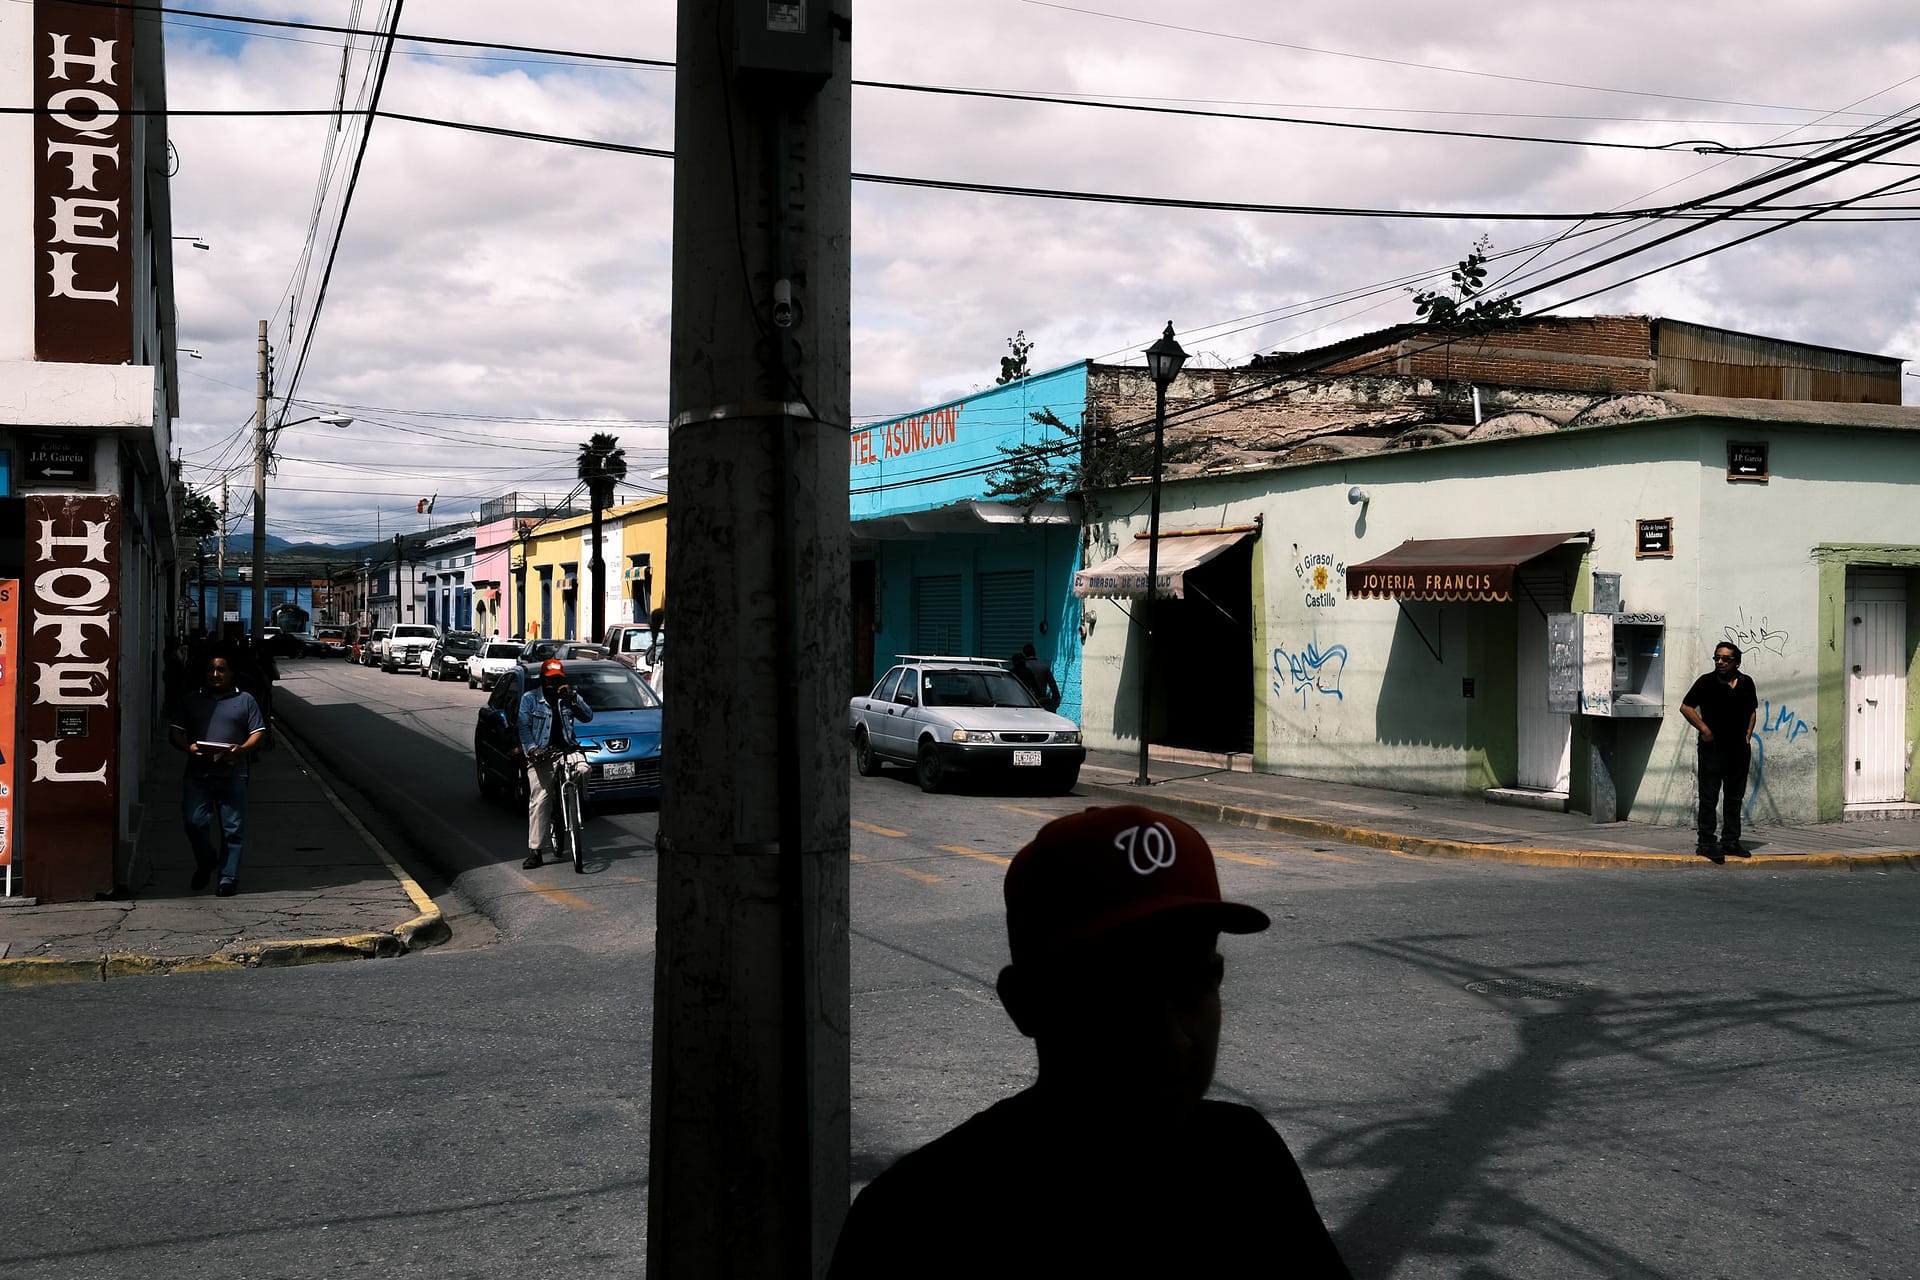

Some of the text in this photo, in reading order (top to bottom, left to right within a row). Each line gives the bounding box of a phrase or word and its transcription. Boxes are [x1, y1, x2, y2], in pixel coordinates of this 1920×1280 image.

[47, 32, 119, 307] HOTEL
[850, 430, 876, 466] TEL
[1295, 553, 1346, 578] El Girasol de
[1135, 574, 1171, 588] CASLLO
[1363, 574, 1491, 590] JOYERIA FRANCIS
[1305, 592, 1336, 608] Castillo
[31, 519, 111, 786] HOTEL
[1113, 821, 1176, 875] W
